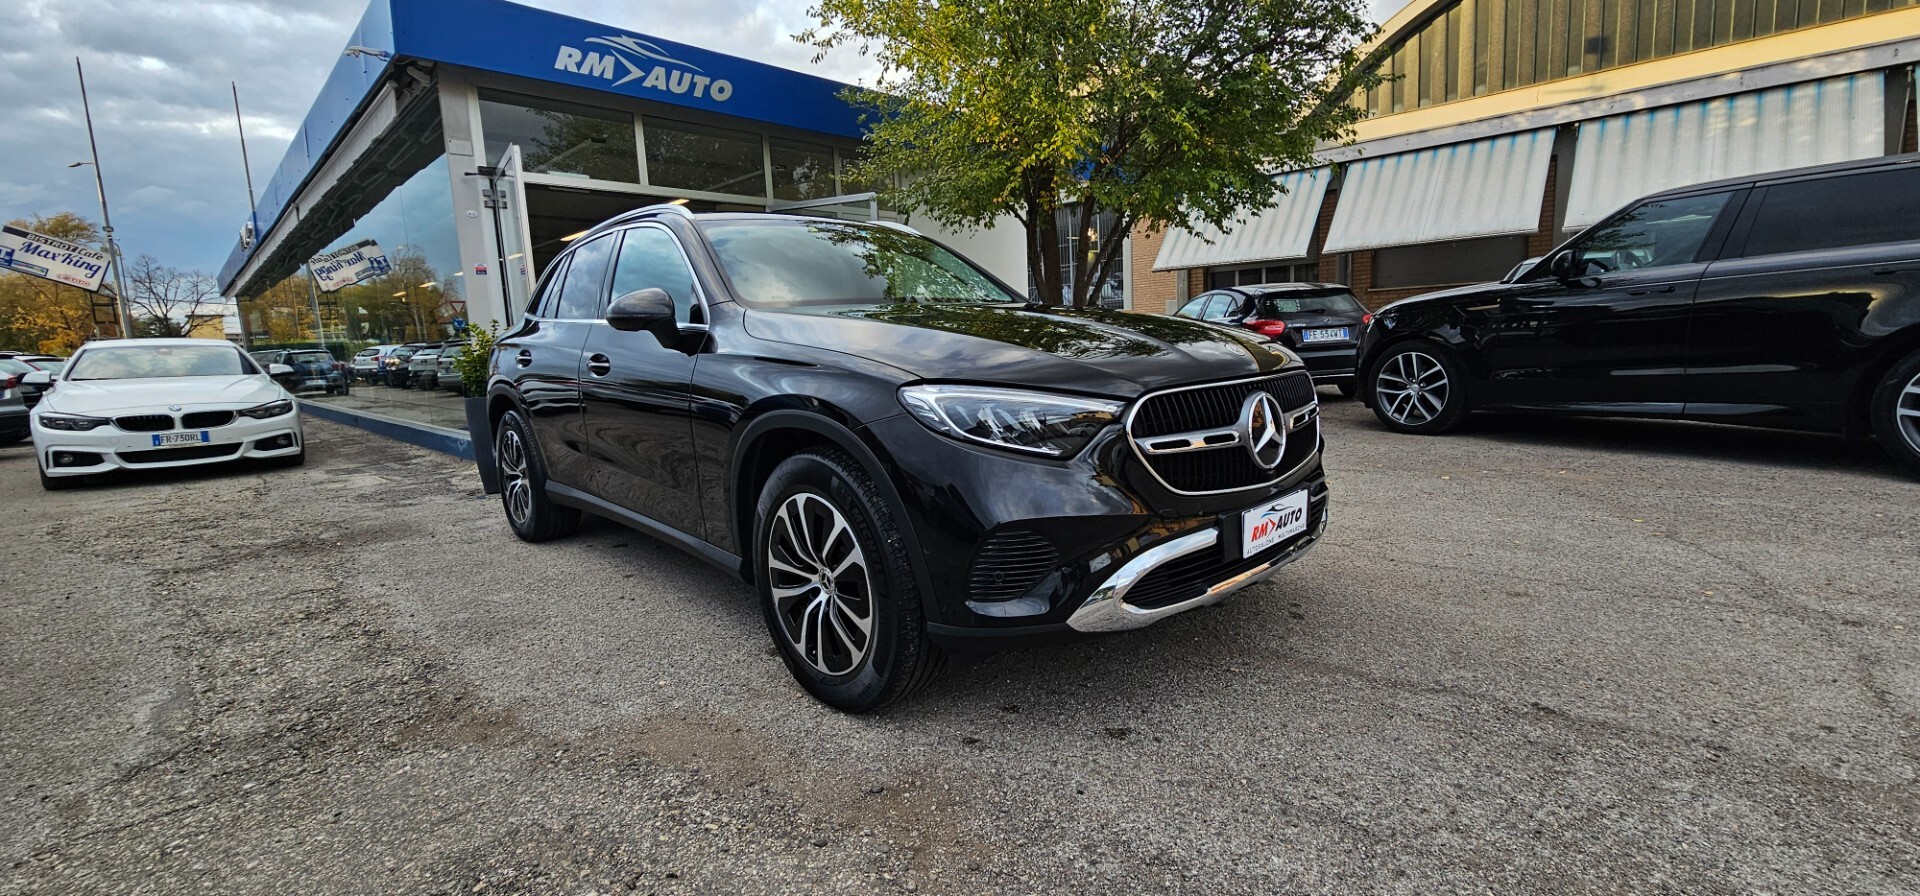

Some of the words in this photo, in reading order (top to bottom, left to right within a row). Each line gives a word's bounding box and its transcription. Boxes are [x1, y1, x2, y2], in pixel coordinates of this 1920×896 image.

[642, 65, 733, 102] AUTO
[26, 233, 76, 252] BISTROT
[77, 247, 104, 260] Café
[1251, 521, 1269, 543] RM
[1275, 507, 1303, 532] AUTO
